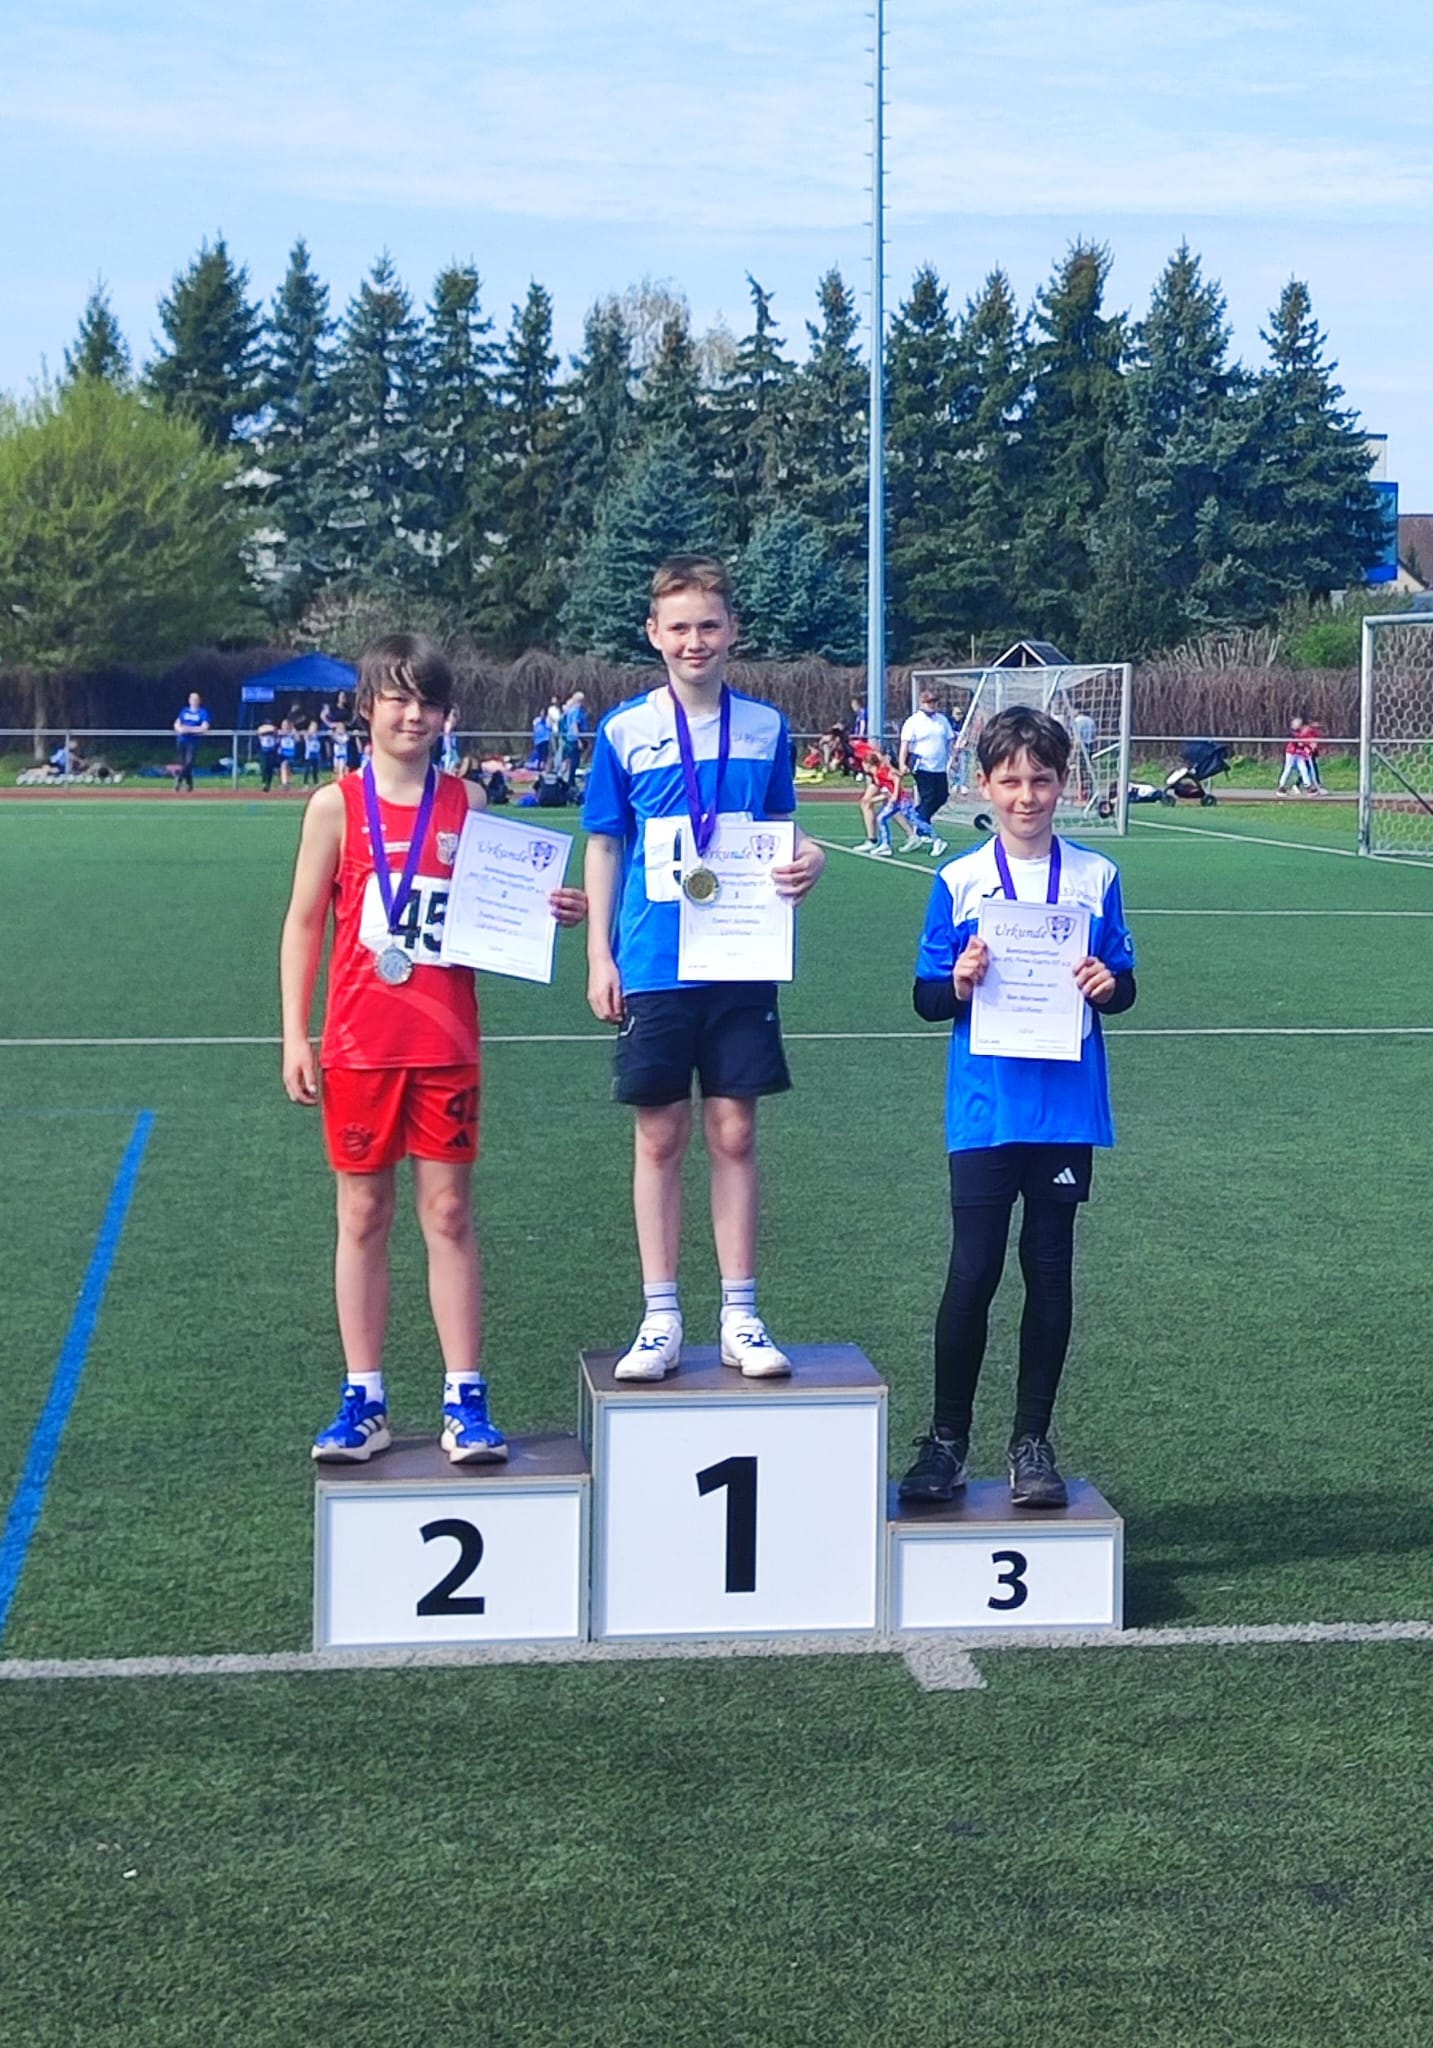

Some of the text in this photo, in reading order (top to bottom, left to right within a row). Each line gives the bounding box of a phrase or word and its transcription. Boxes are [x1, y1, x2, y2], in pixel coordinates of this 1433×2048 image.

[390, 888, 450, 953] 45
[994, 923, 1048, 940] Urkunde
[697, 1457, 757, 1593] 1
[417, 1518, 485, 1617] 2
[987, 1551, 1029, 1610] 3
